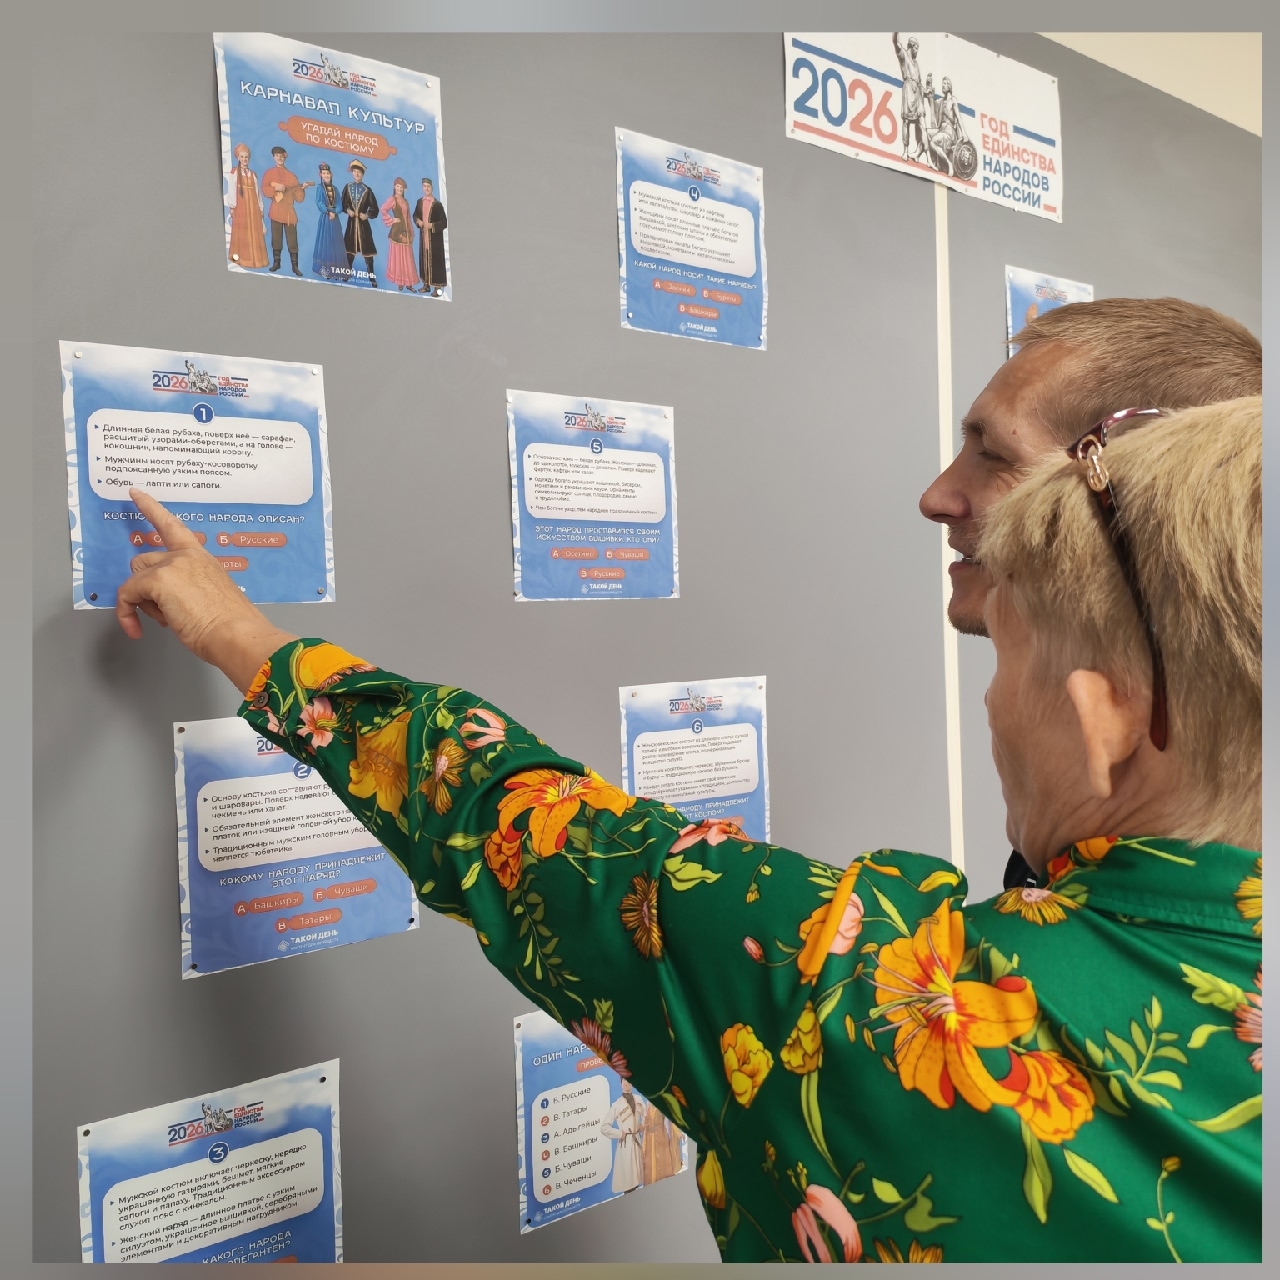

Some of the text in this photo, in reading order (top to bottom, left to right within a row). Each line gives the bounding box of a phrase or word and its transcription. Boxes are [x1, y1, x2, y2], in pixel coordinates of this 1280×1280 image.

[293, 62, 323, 79] 2026
[792, 58, 897, 144] 2026
[240, 81, 425, 135] КАРНАВАЛ КУЛЬТУР
[980, 113, 1009, 139] ГОД
[301, 122, 379, 146] УГАДАЙ НАРОД
[306, 133, 374, 154] ПО КОСТЮМУ
[982, 134, 1056, 174] ЕДИНСТВА
[983, 158, 1049, 192] НАРОДОВ
[983, 176, 1041, 208] РОССИИ
[331, 266, 376, 279] ТАКОЙ ДЕНЬ
[635, 261, 657, 269] КАКОЙ
[659, 266, 681, 276] НАРОД
[153, 373, 188, 388] 2026
[200, 408, 206, 420] 1
[565, 416, 587, 427] 2026
[103, 424, 142, 433] Длинная
[104, 434, 149, 442] расшитый
[593, 442, 600, 451] 5
[105, 456, 148, 464] Мужчины
[106, 478, 133, 487] Обувь
[209, 513, 305, 523] НАРОДА ОПИСАН?
[134, 534, 142, 544] А
[220, 535, 279, 544] Б Русские
[670, 701, 689, 711] 2026
[694, 721, 700, 731] 6
[298, 764, 307, 776] 2
[219, 852, 386, 887] КАКОМУ НАРОДУ ПРИНАДЛЕЖИТ
[334, 883, 368, 896] Чуваши
[237, 904, 246, 913] А
[300, 913, 332, 926] Татары
[291, 930, 338, 944] ТАКОЙ ДЕНЬ
[533, 1044, 592, 1066] ОДИН НАР
[562, 1088, 591, 1102] Русские
[562, 1106, 588, 1119] Татары
[168, 1124, 203, 1142] 2026
[213, 1147, 224, 1160] 3
[162, 1179, 192, 1192] костюм
[119, 1209, 149, 1222] сапоги
[249, 1231, 292, 1250] НАРОДА
